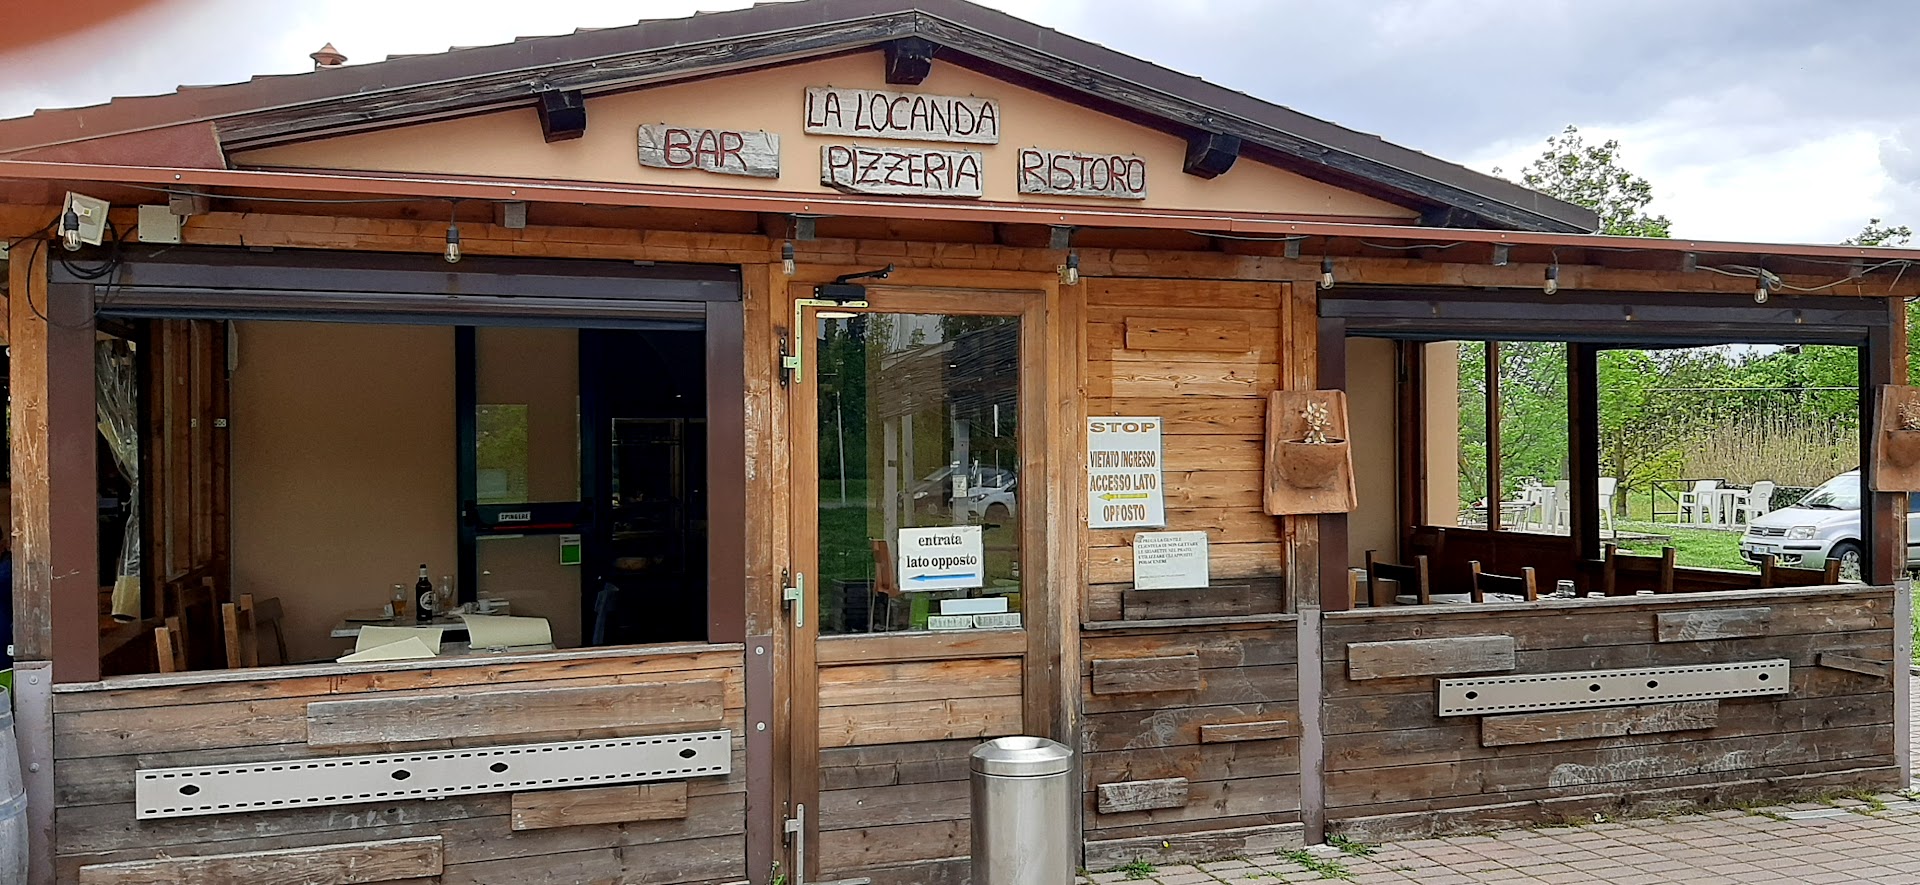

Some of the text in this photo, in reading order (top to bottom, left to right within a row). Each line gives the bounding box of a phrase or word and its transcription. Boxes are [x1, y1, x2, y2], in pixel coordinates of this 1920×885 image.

[806, 92, 998, 136] LA LOCANDA
[664, 129, 747, 172] BAR
[828, 146, 982, 192] PIZZERIA
[1021, 150, 1146, 194] RISTORO
[1089, 422, 1156, 433] STOP
[1089, 450, 1156, 468] VIETATO INGRESSO
[1089, 473, 1156, 492] ACCESSO LATO
[1103, 504, 1146, 522] OPPOSTO
[918, 533, 963, 547] entrata
[906, 553, 978, 570] lato opposto
